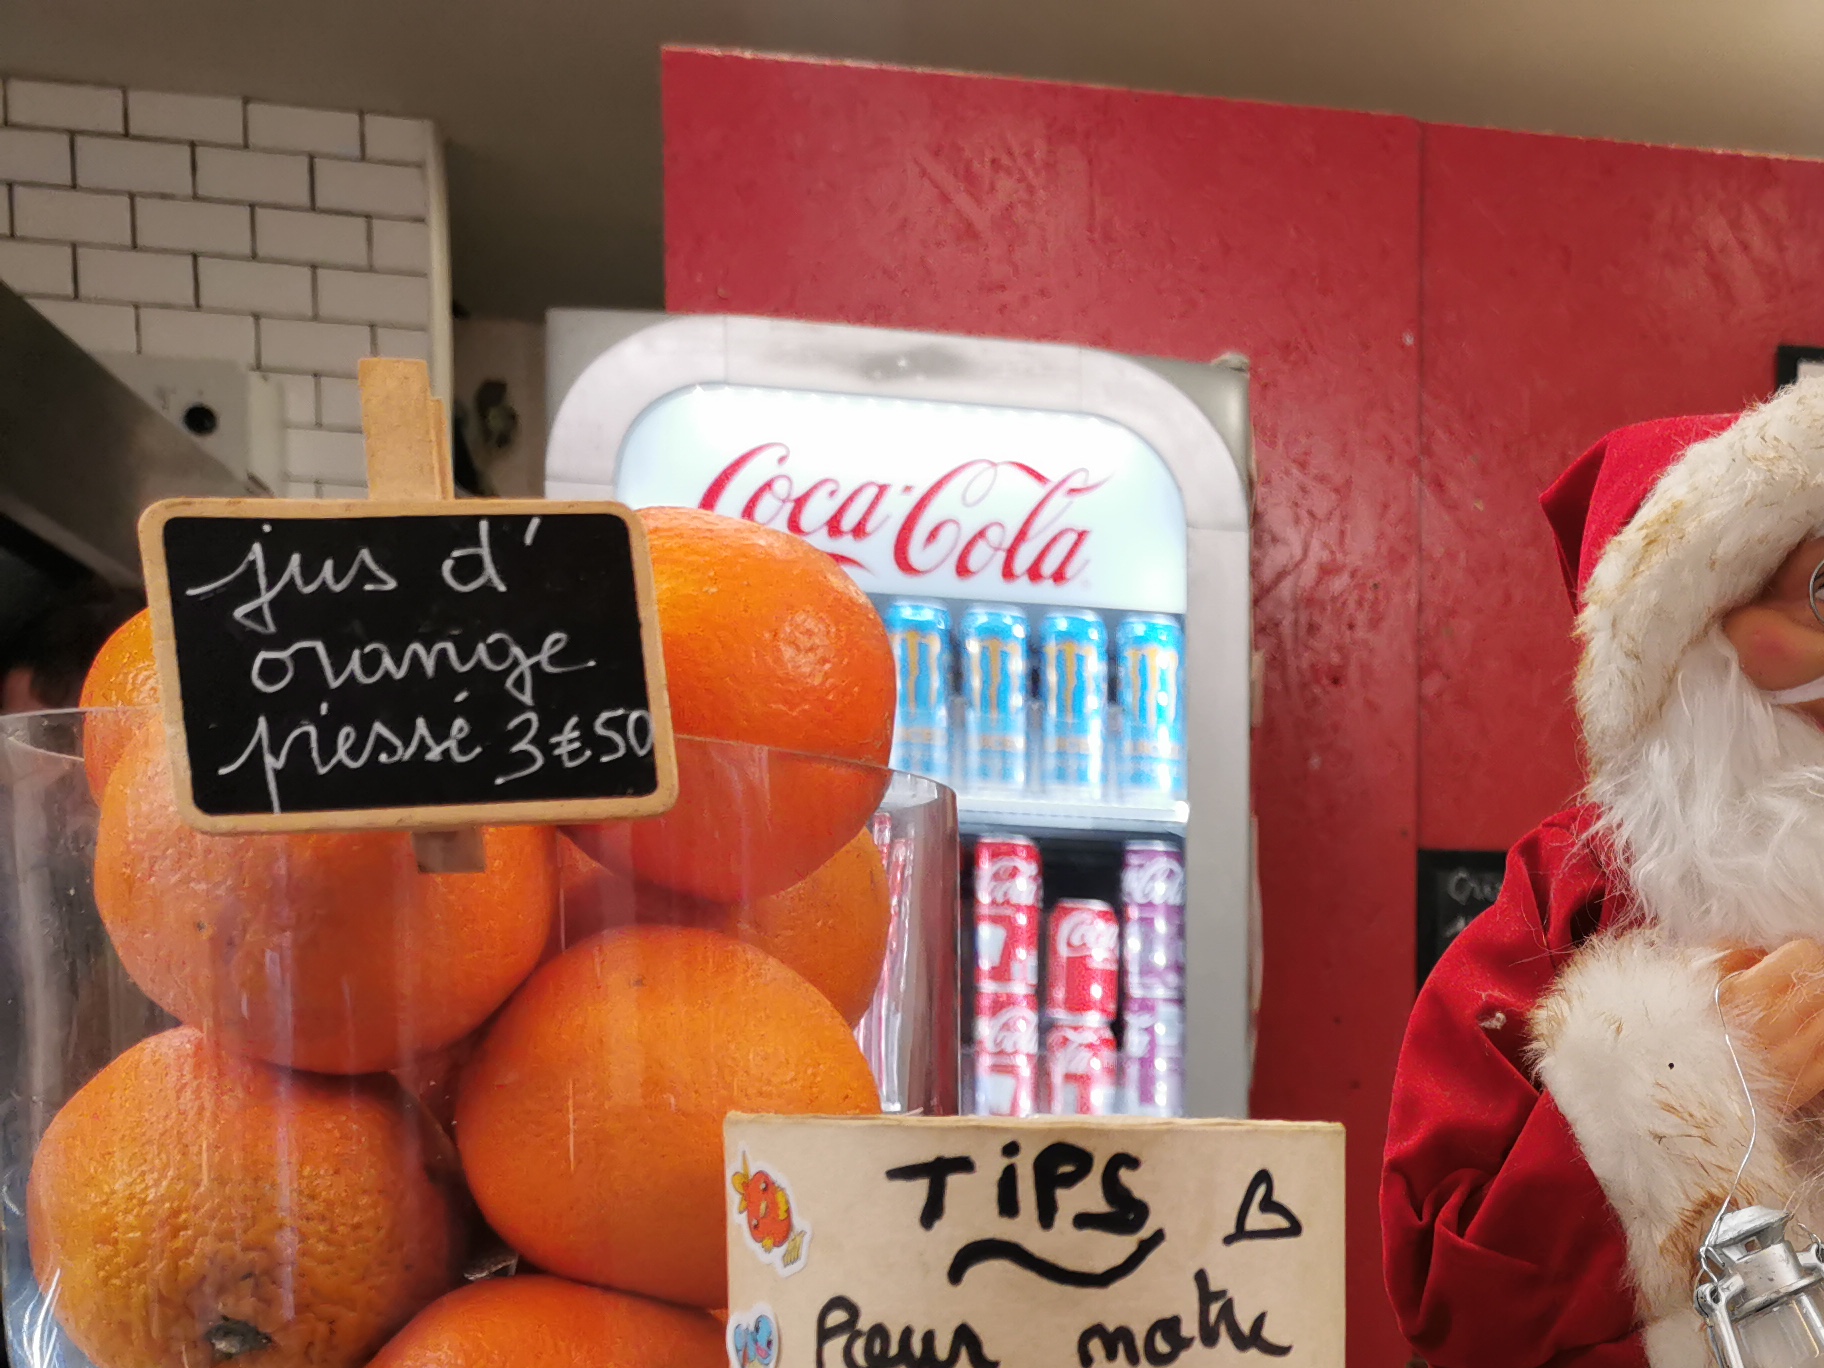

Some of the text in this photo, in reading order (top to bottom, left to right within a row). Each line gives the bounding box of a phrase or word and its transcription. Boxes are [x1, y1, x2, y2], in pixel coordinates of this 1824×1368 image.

[697, 441, 1115, 585] Coca-Cola
[185, 523, 398, 634] jus
[250, 632, 597, 706] orange
